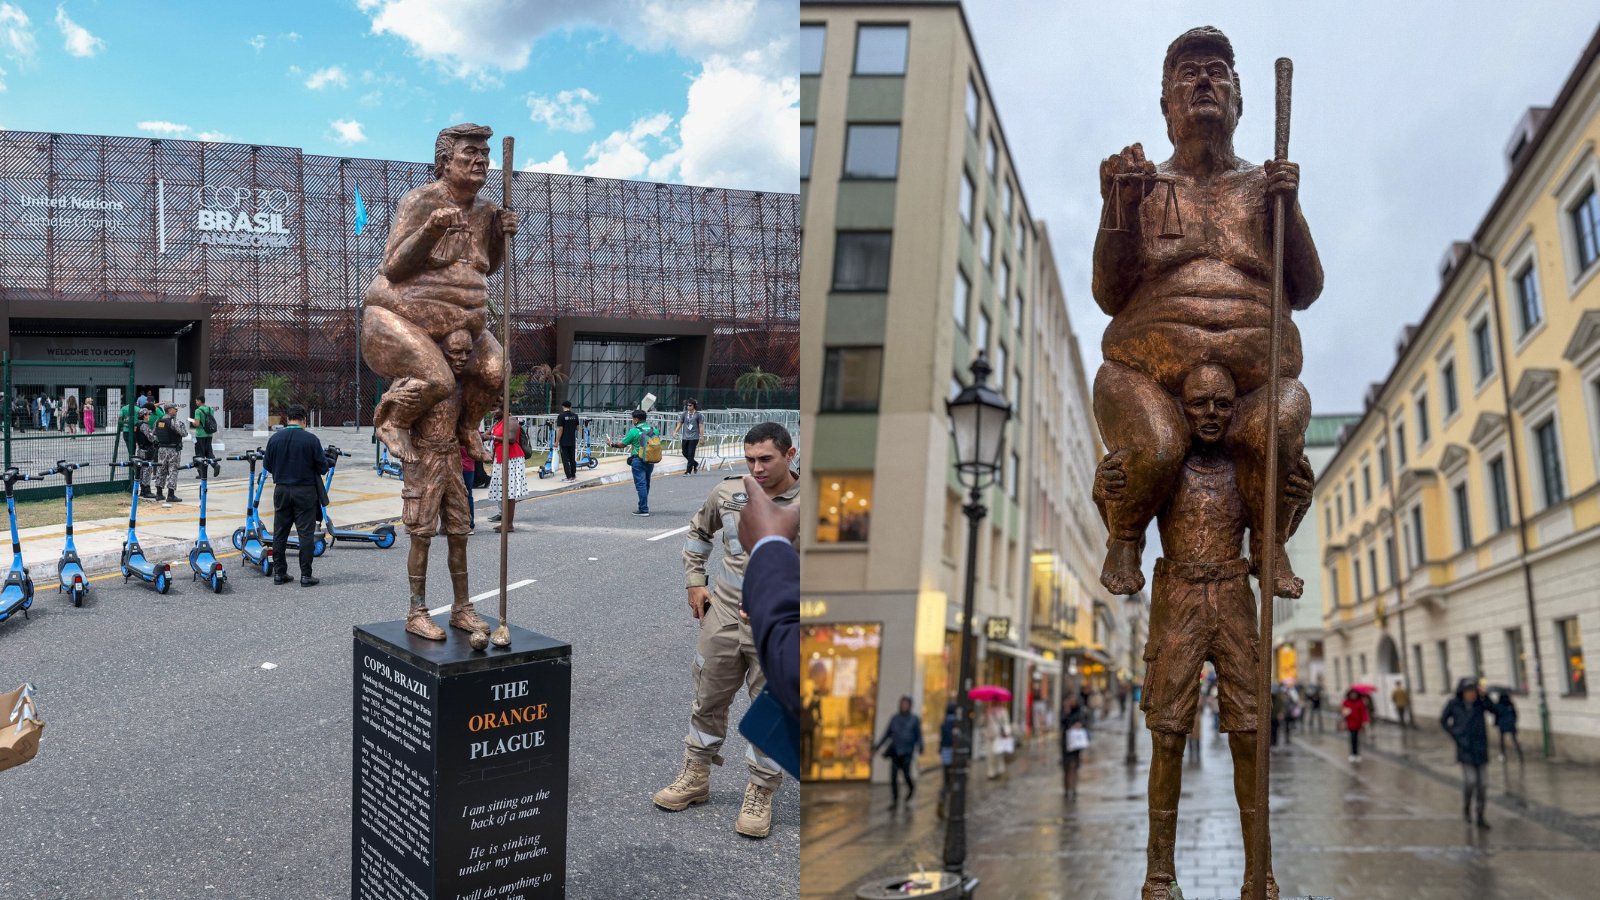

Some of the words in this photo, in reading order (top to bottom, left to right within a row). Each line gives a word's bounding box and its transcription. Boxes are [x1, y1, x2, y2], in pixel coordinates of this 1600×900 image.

[21, 194, 67, 209] United
[71, 196, 124, 210] Nations
[199, 185, 289, 212] COP30
[21, 213, 71, 228] Climate
[75, 214, 125, 232] Change
[199, 209, 290, 234] BRASIL
[47, 348, 89, 356] WELCOME
[90, 348, 102, 356] TO
[364, 655, 393, 682] COP30,
[393, 669, 430, 700] BRAZIL
[491, 680, 528, 701] THE
[362, 672, 378, 688] Marking
[377, 681, 385, 690] the
[384, 686, 394, 695] next
[393, 691, 402, 701] step
[402, 695, 412, 705] after
[412, 700, 420, 710] the
[420, 704, 432, 716] Paris
[468, 703, 548, 732] ORANGE
[470, 730, 545, 760] PLAGUE
[462, 806, 468, 818] I
[469, 805, 485, 817] am
[487, 798, 518, 812] sitting
[521, 794, 533, 804] on
[535, 789, 550, 801] the
[470, 815, 495, 830] back
[496, 811, 509, 826] of
[509, 812, 516, 821] a
[518, 807, 541, 819] man.
[469, 846, 485, 860] He
[489, 844, 498, 855] is
[501, 834, 541, 852] sinking
[459, 861, 491, 876] under
[494, 856, 511, 868] my
[513, 846, 549, 862] burden.
[483, 885, 496, 899] do
[498, 876, 541, 894] anything
[542, 873, 552, 882] to
